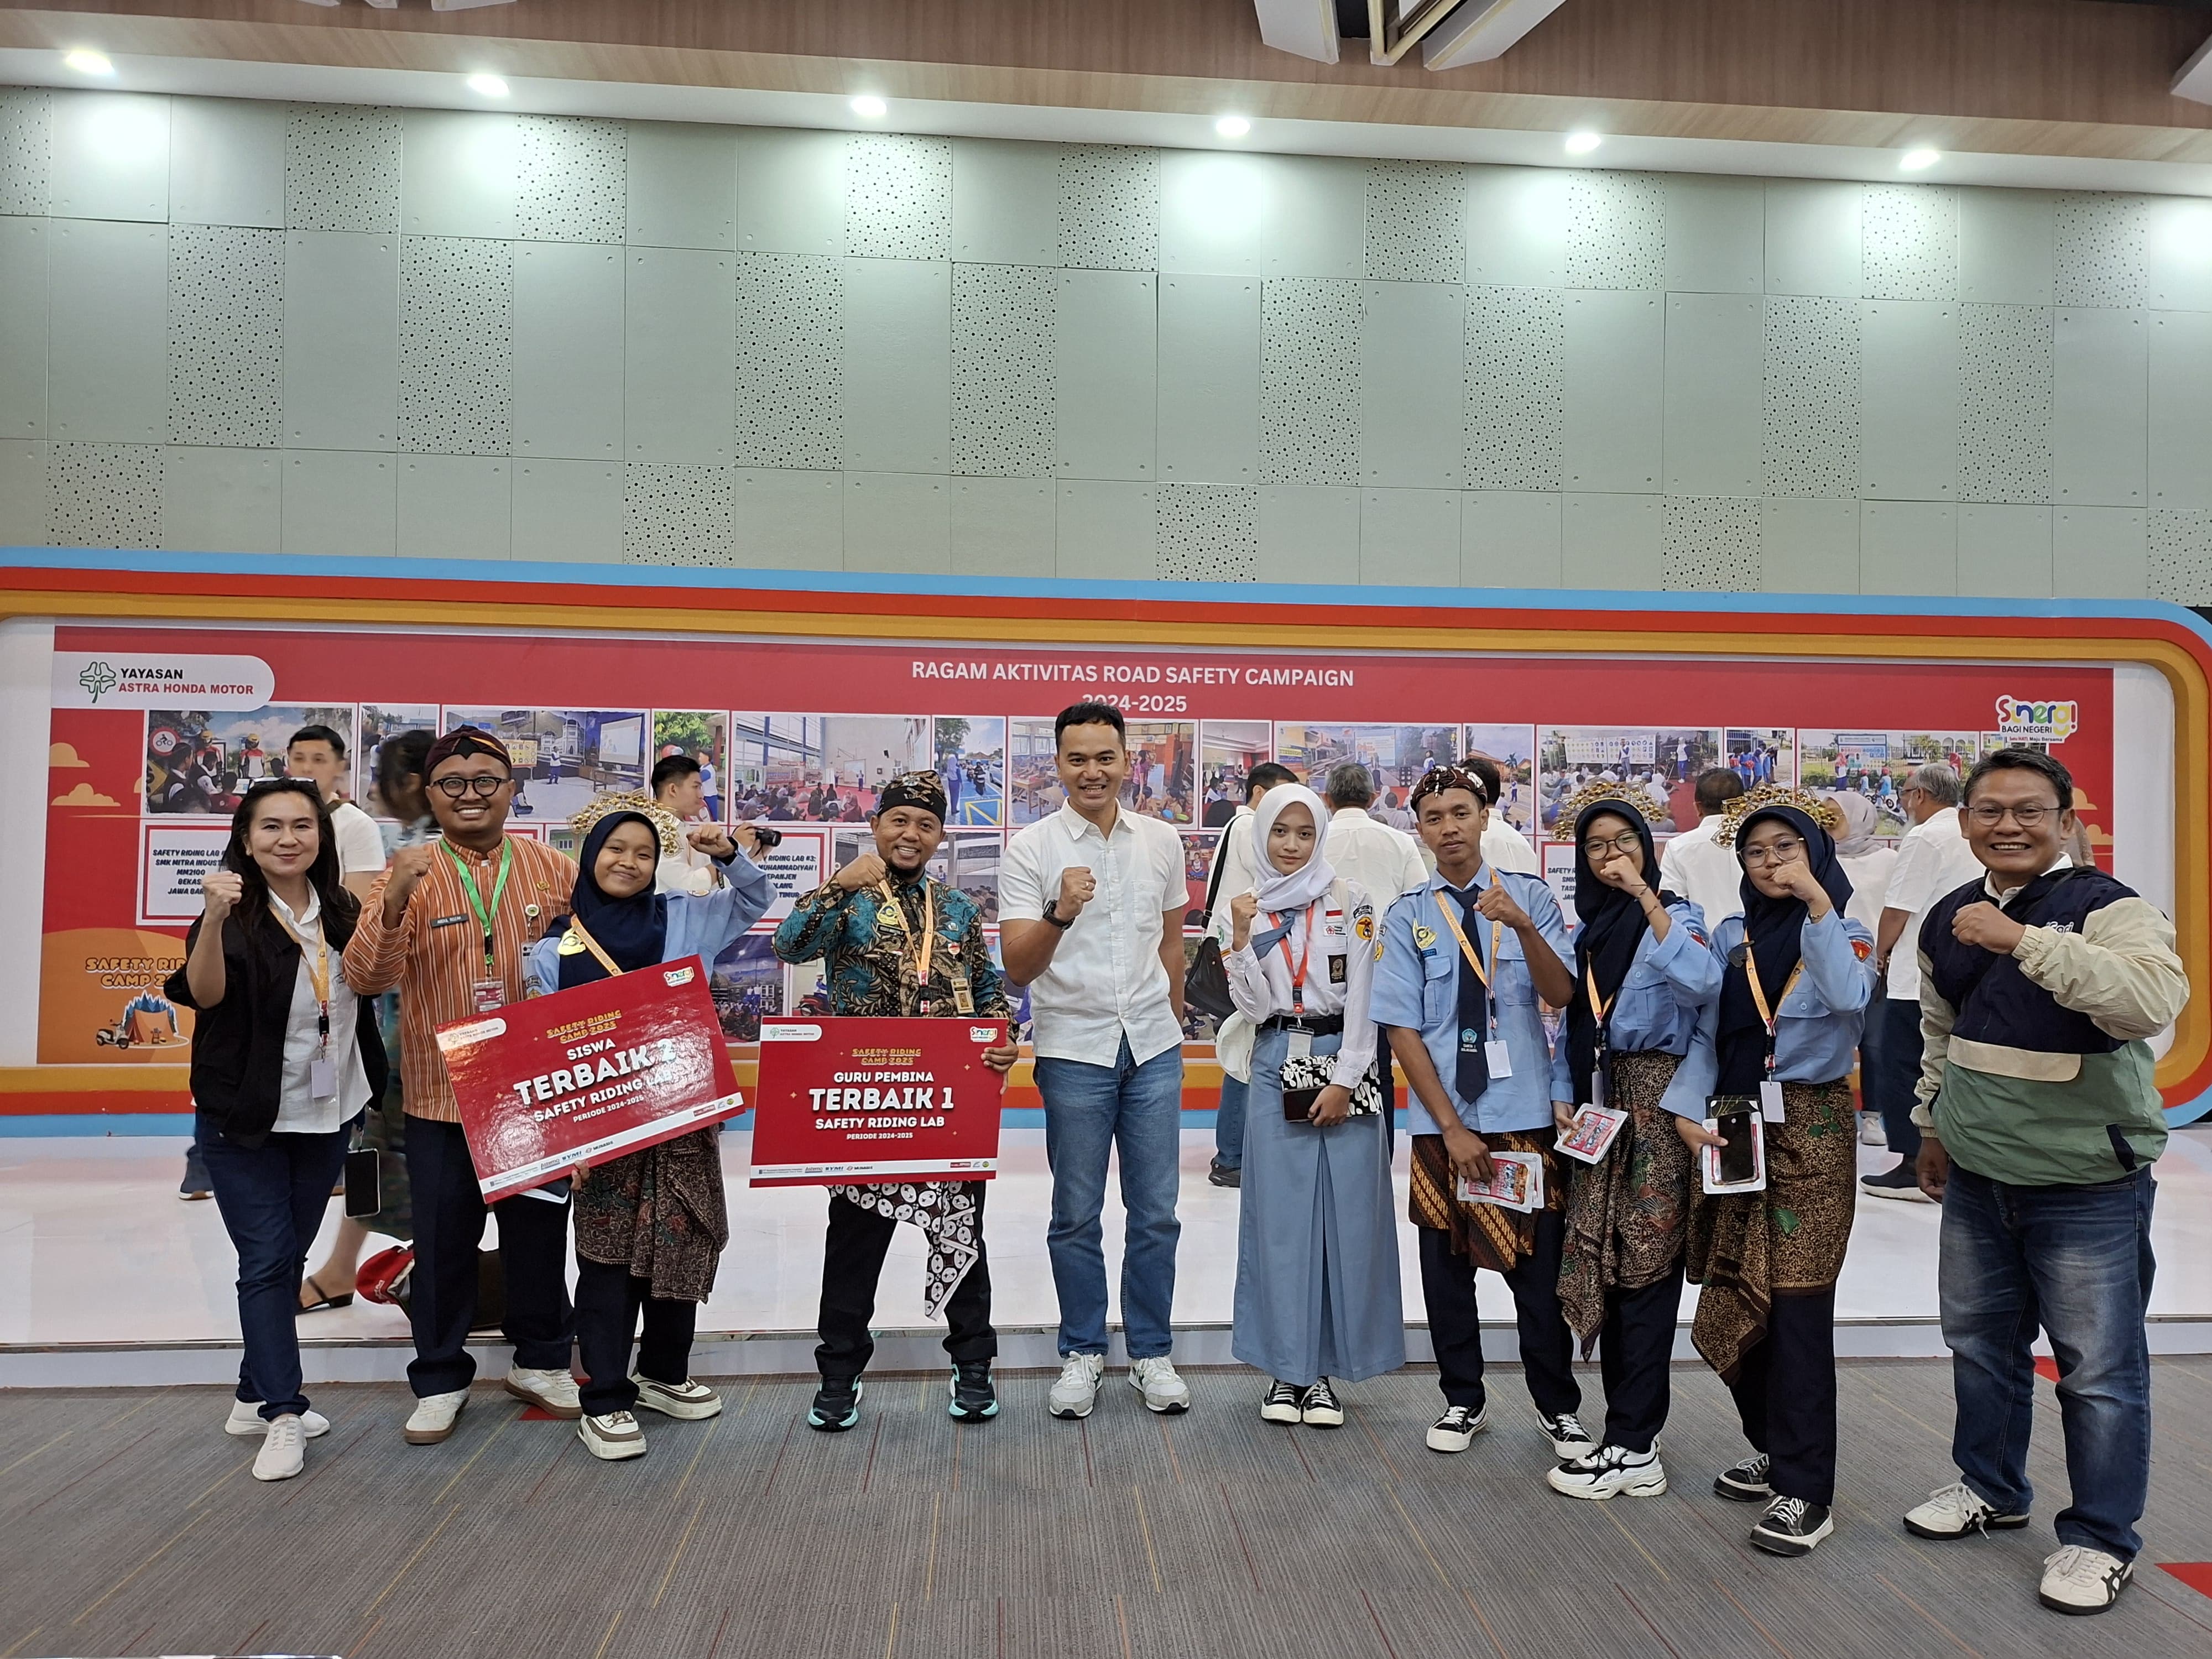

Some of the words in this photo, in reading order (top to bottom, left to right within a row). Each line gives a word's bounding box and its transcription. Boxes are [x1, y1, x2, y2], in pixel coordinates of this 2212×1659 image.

[121, 668, 183, 680] YAYASAN
[912, 662, 987, 680] RAGAM
[993, 663, 1098, 682] AKTIVITAS
[1103, 665, 1160, 683] ROAD
[1166, 667, 1240, 685] SAFETY
[1245, 669, 1354, 686] CAMPAIGN
[118, 683, 159, 693] ASTRA
[163, 684, 206, 694] HONDA
[210, 685, 254, 695] MOTOR
[86, 957, 154, 972] SAFETY
[101, 973, 152, 988] CAMP
[546, 1020, 586, 1038] SAFETY
[587, 1010, 622, 1026] RIDING
[560, 1029, 588, 1044] CAMP
[567, 1038, 616, 1060] SISWA
[852, 1048, 888, 1057] SAFETY
[889, 1048, 922, 1057] RIDING
[861, 1057, 887, 1066] CAMP
[513, 1045, 654, 1105] TERBAIK
[834, 1072, 872, 1083] GURU
[875, 1071, 935, 1082] PEMBINA
[534, 1096, 587, 1122] SAFETY
[589, 1078, 643, 1104] RIDING
[809, 1088, 933, 1110] TERBAIK
[941, 1087, 954, 1109] 1
[573, 1108, 606, 1123] PERIODE
[607, 1095, 644, 1112] 2024-2025
[815, 1118, 865, 1129] SAFETY
[867, 1117, 917, 1128] RIDING
[920, 1117, 945, 1127] LAB
